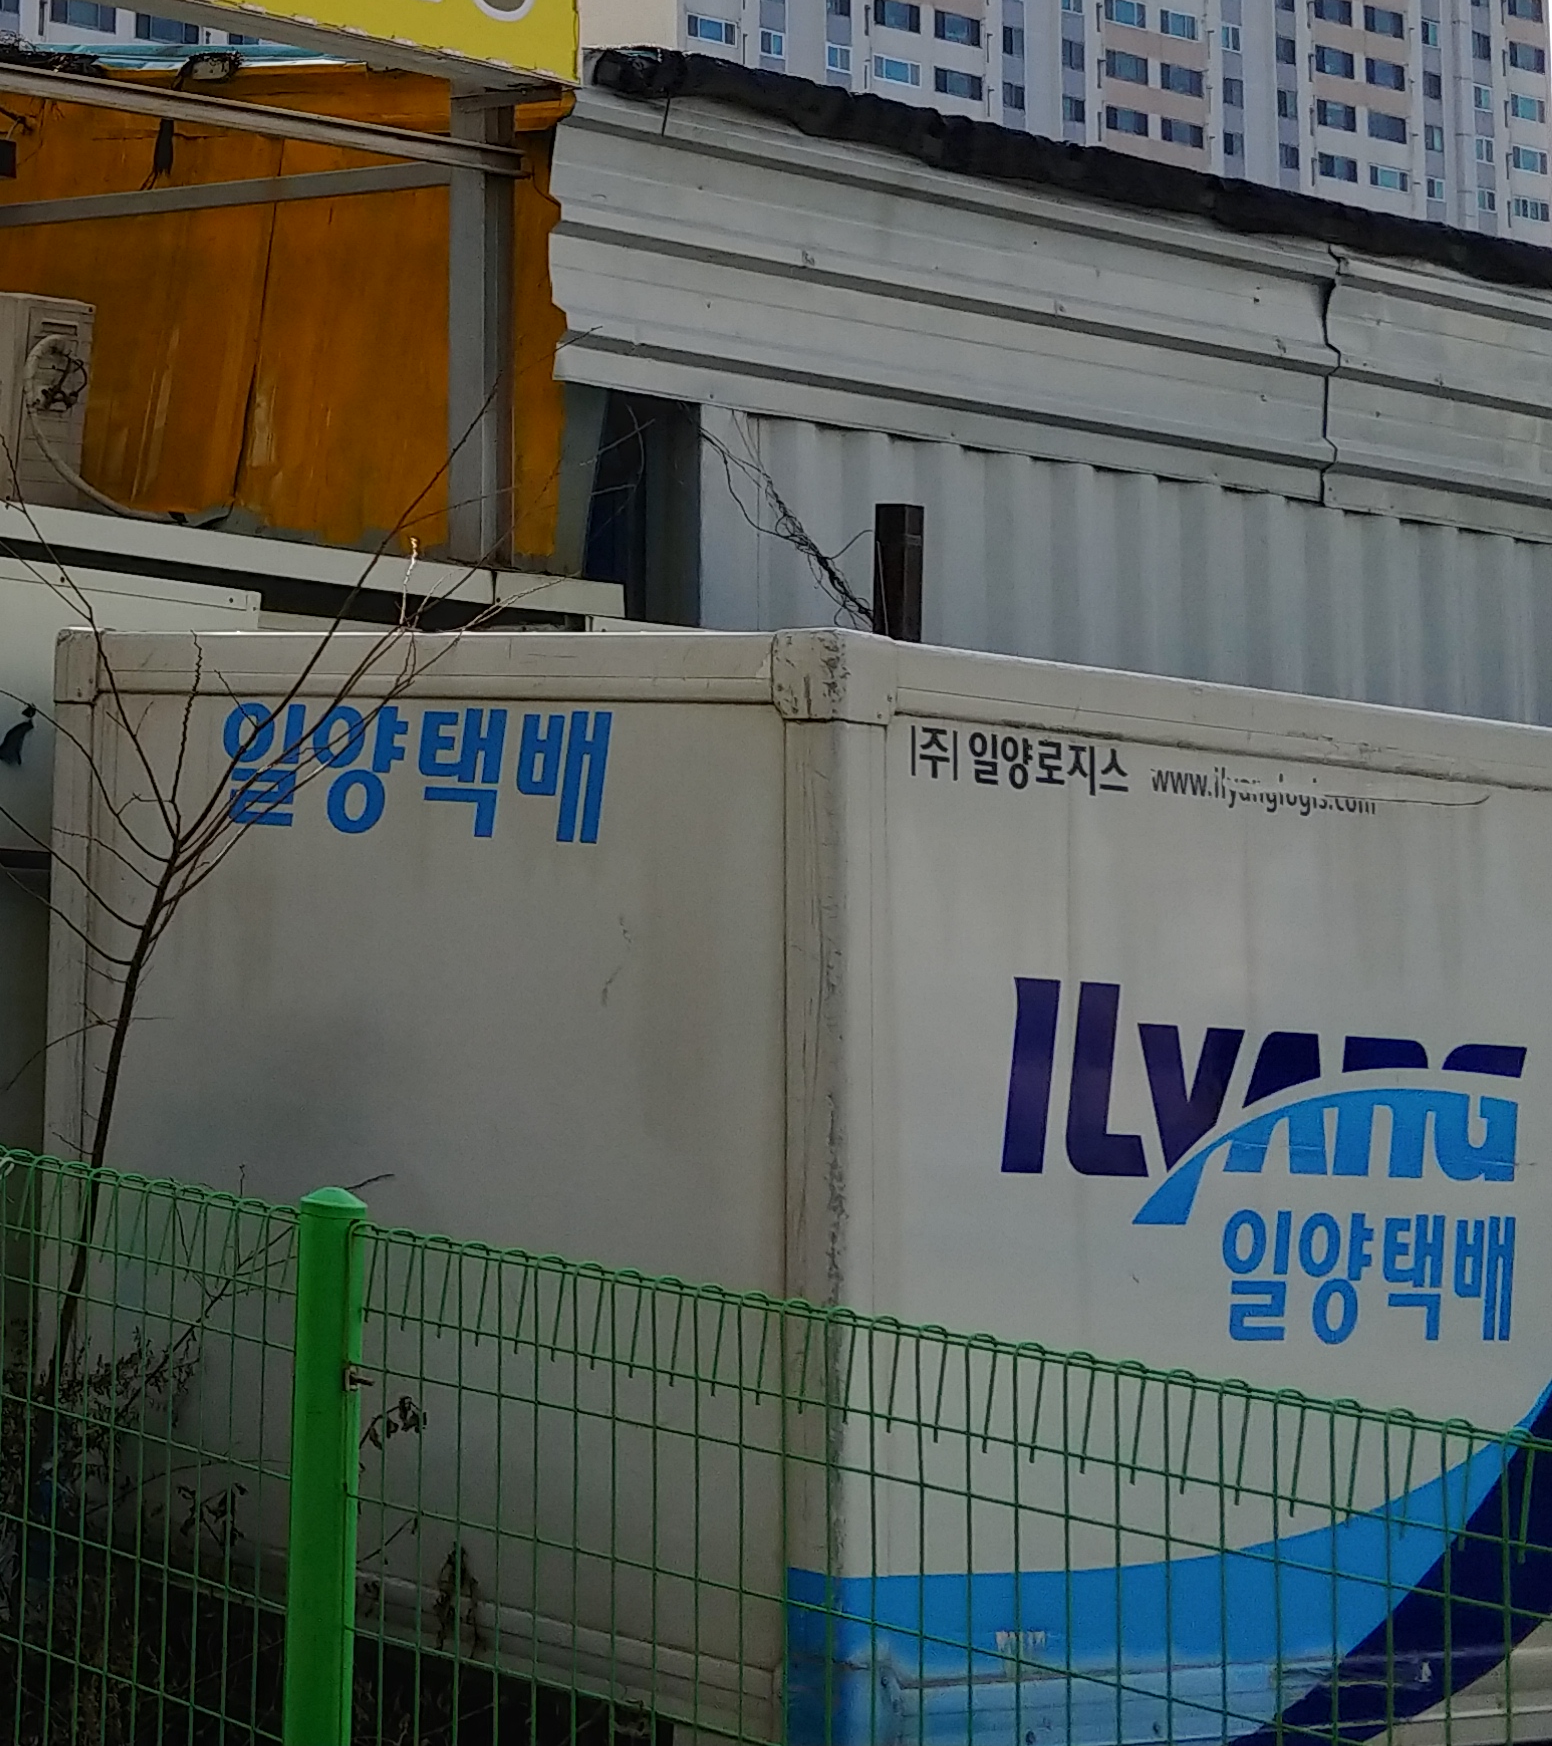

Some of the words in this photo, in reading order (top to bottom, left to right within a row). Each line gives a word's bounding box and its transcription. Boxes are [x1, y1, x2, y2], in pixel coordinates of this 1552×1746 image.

[222, 701, 614, 845] 일양택배
[967, 730, 1131, 797] 일양로지스
[1221, 1208, 1517, 1346] 일양택배
